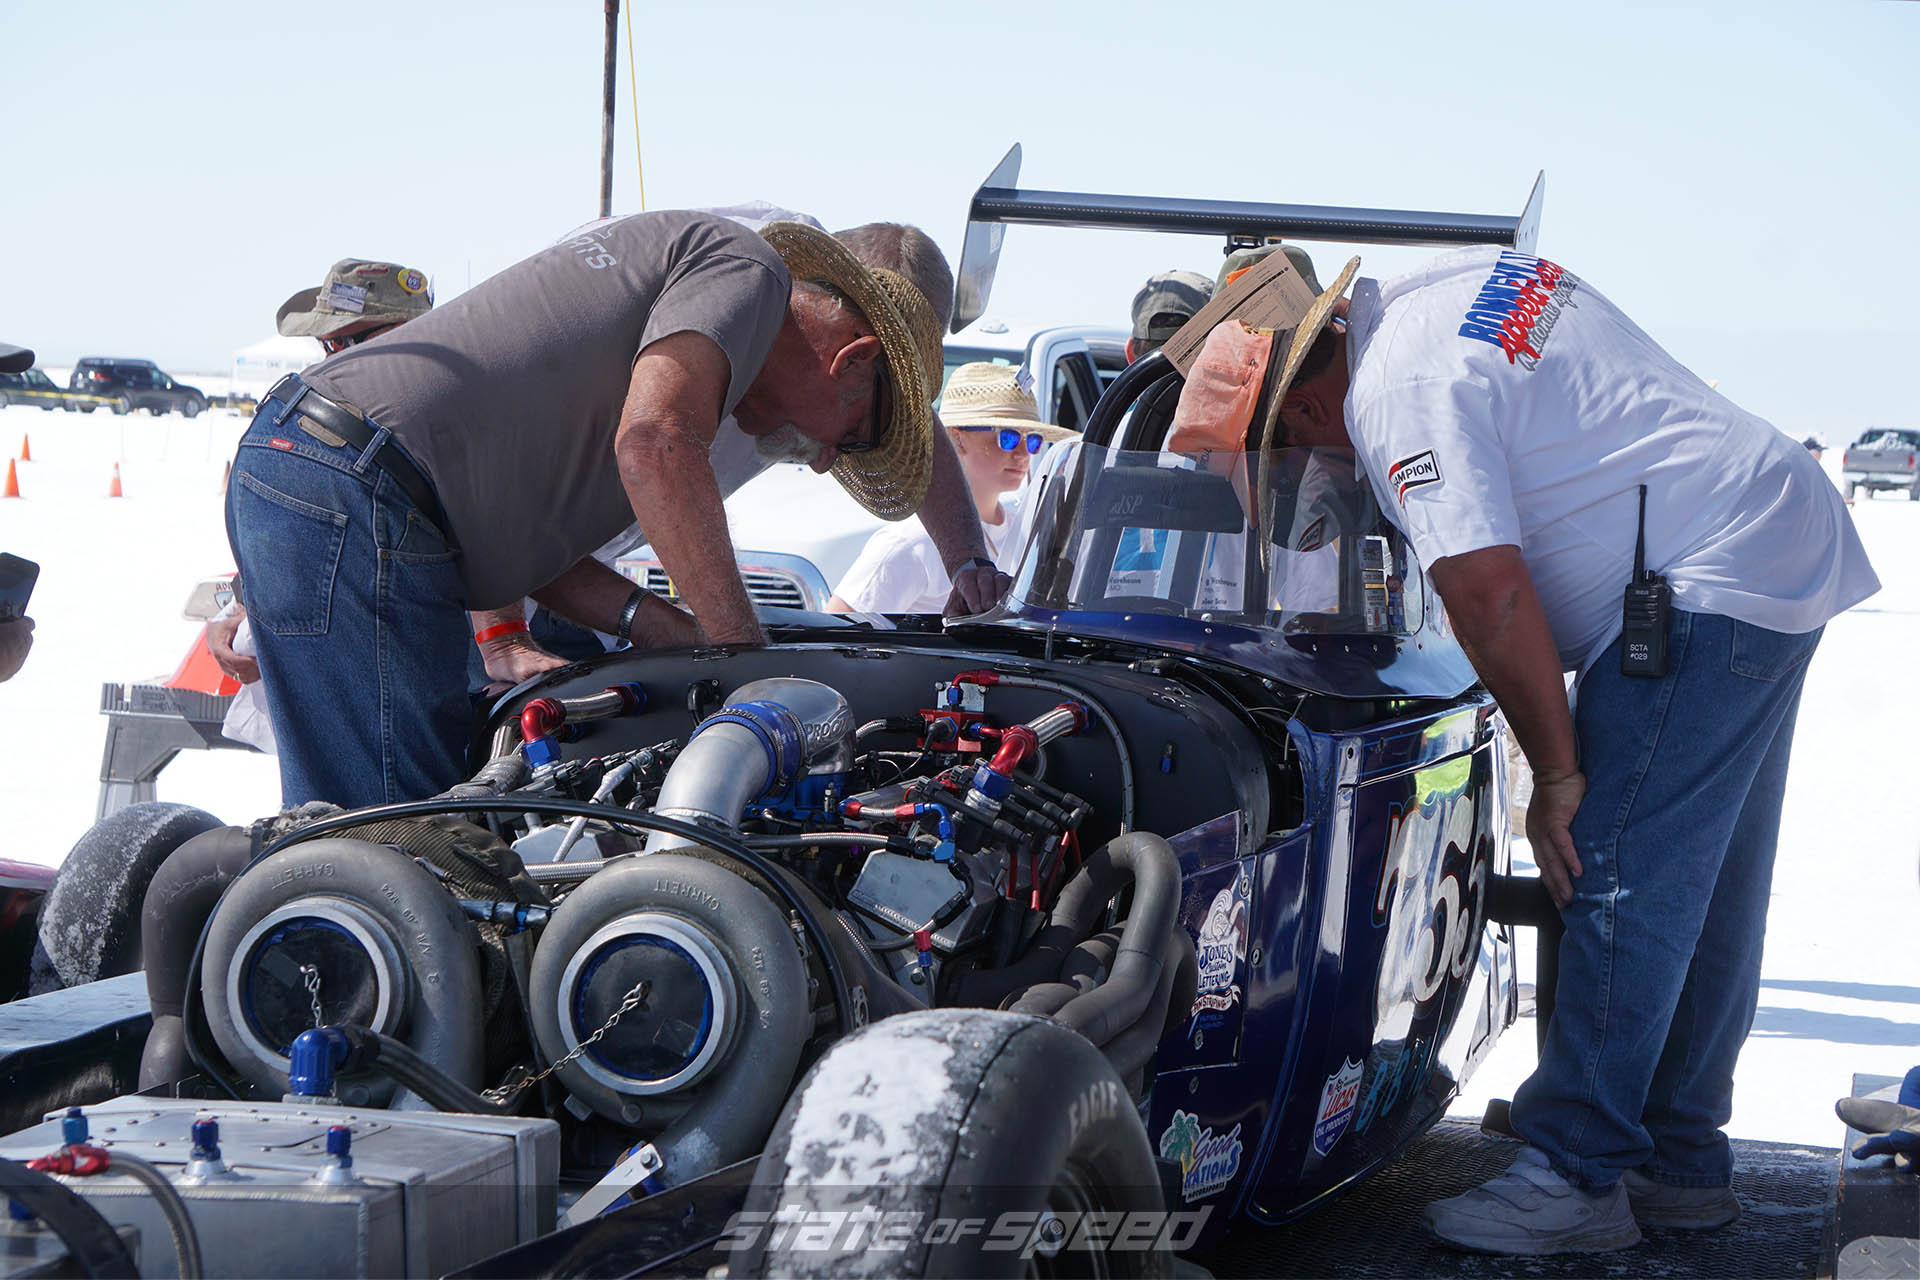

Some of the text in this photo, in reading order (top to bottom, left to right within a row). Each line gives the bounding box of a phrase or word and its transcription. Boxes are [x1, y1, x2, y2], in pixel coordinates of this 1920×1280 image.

[1629, 643, 1648, 652] SCTA
[271, 863, 337, 890] GARRETT
[653, 878, 721, 912] GARRETT
[1199, 944, 1234, 970] JONES
[1198, 971, 1231, 989] LETTERING
[1068, 1080, 1119, 1146] EAGLE
[1321, 1082, 1359, 1121] LUCAS
[1183, 1144, 1240, 1190] NATIONS
[1189, 1124, 1241, 1177] Good
